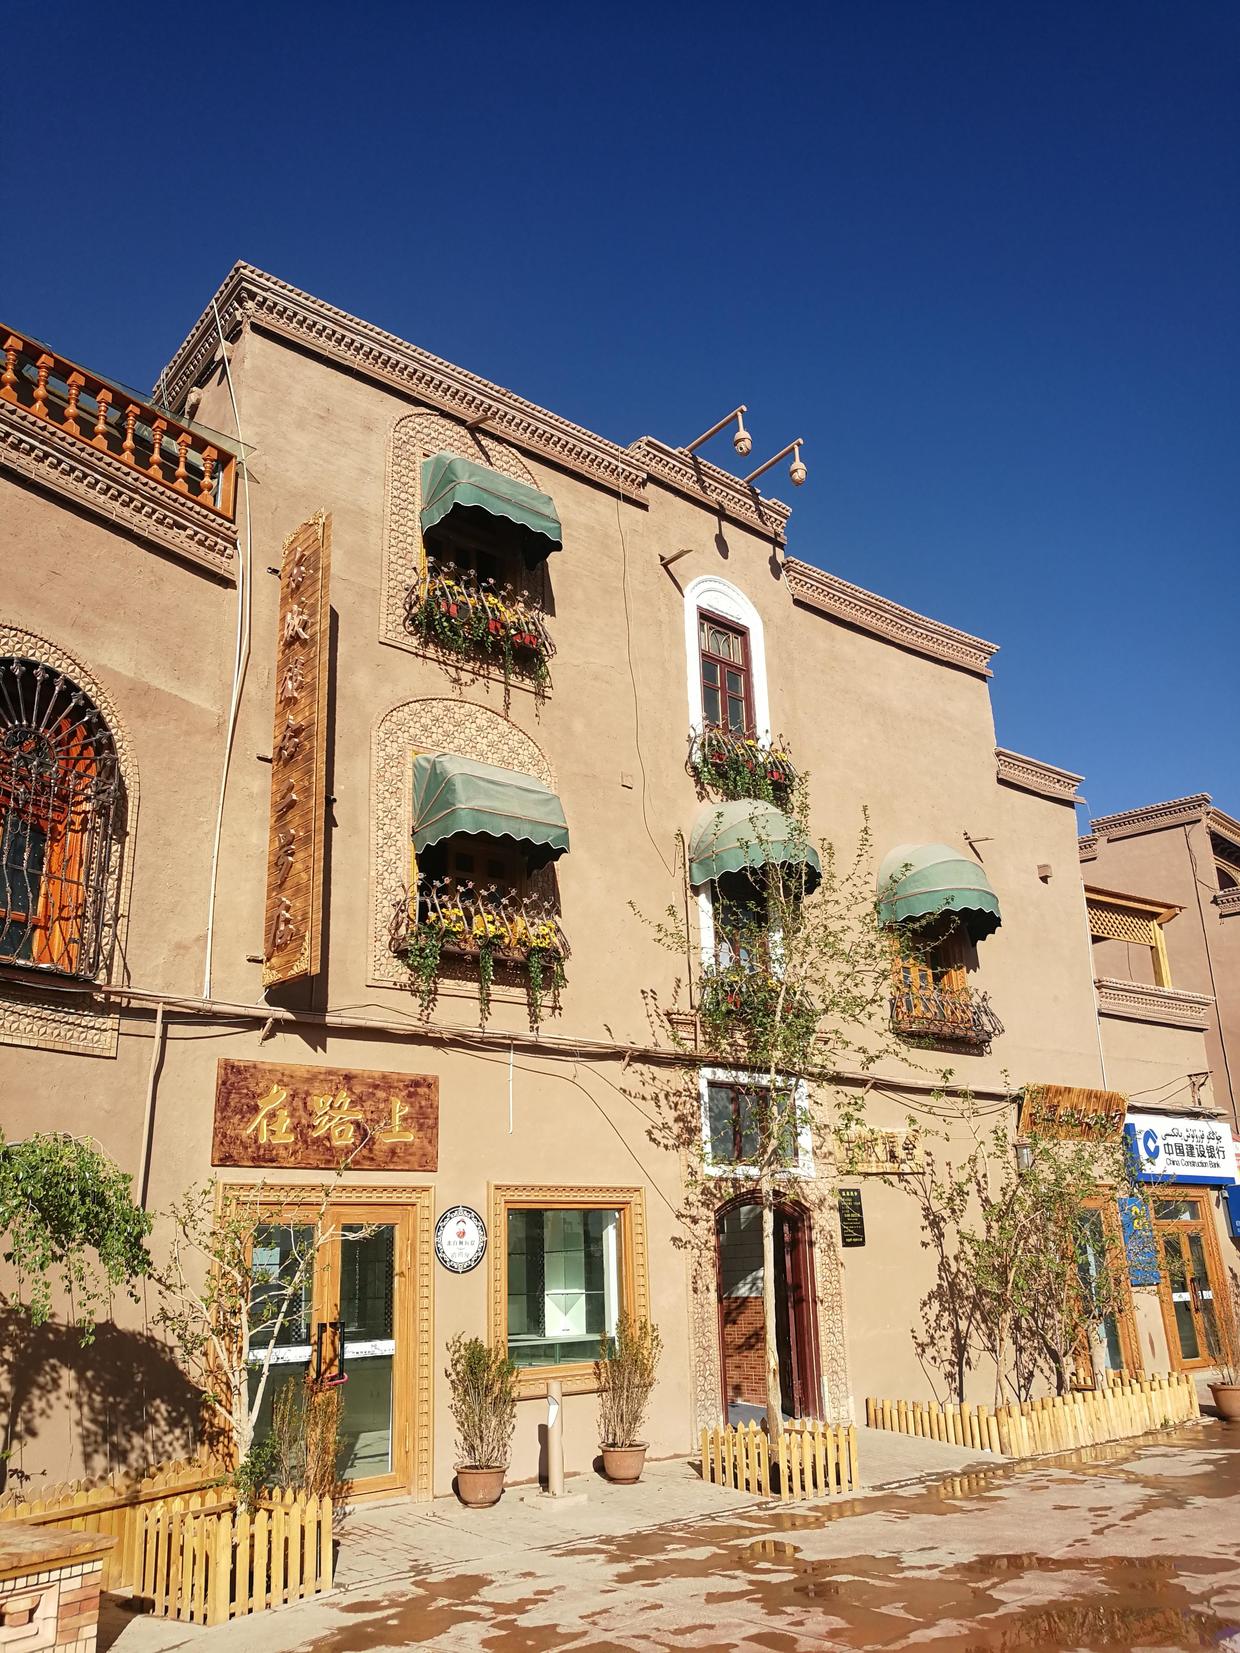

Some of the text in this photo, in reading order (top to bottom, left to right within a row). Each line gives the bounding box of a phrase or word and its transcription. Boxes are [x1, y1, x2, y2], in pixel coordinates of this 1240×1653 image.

[246, 1083, 414, 1144] 在路上
[1163, 1142, 1226, 1160] 中国建设银行
[1166, 1158, 1221, 1168] China Construction Bank
